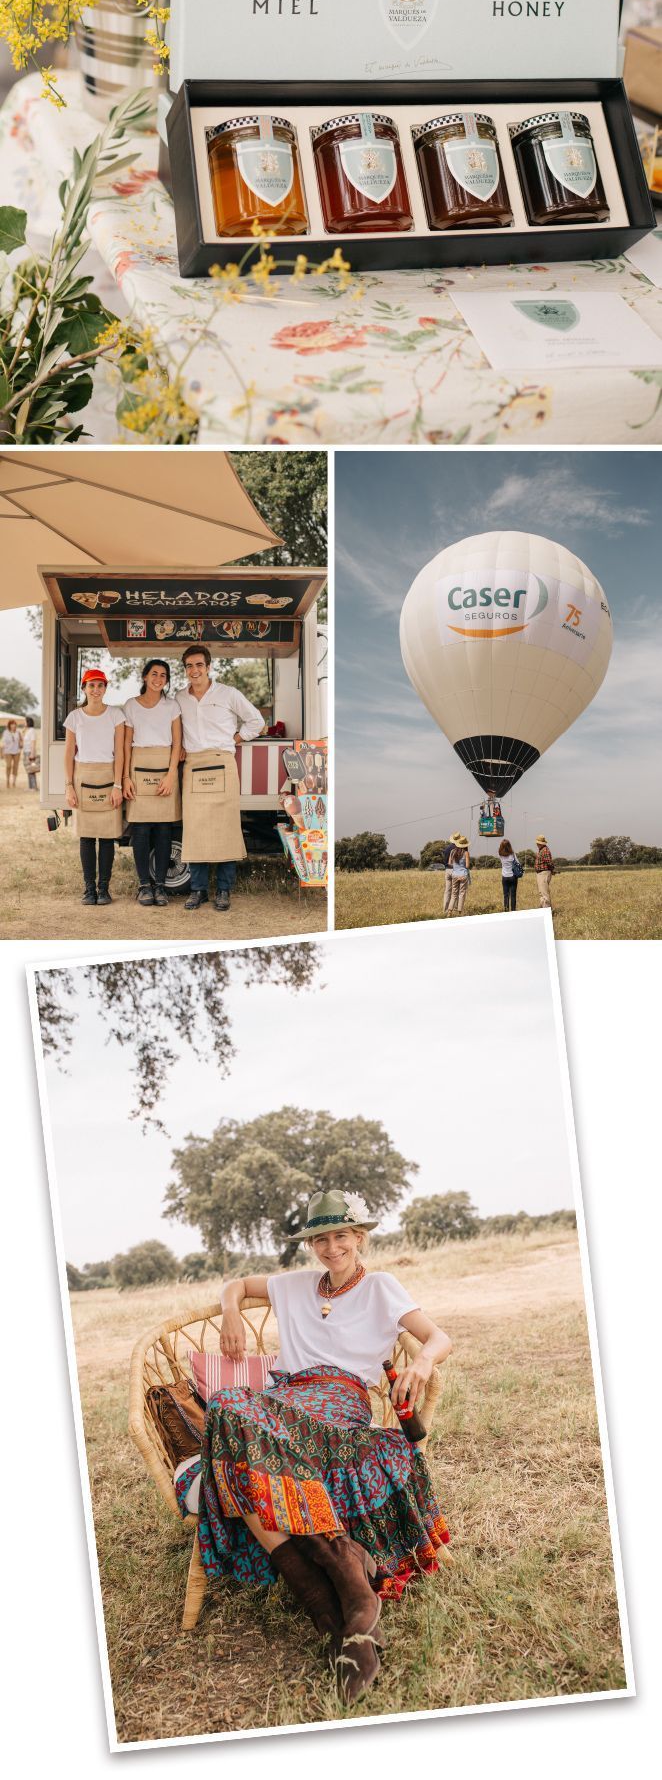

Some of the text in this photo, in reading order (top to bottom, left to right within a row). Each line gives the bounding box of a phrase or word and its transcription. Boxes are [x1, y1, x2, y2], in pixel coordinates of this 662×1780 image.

[492, 0, 565, 17] HONEY
[125, 590, 242, 601] HELADOS
[447, 586, 527, 610] Caser
[465, 612, 518, 620] SEGUROS
[565, 603, 582, 627] 75
